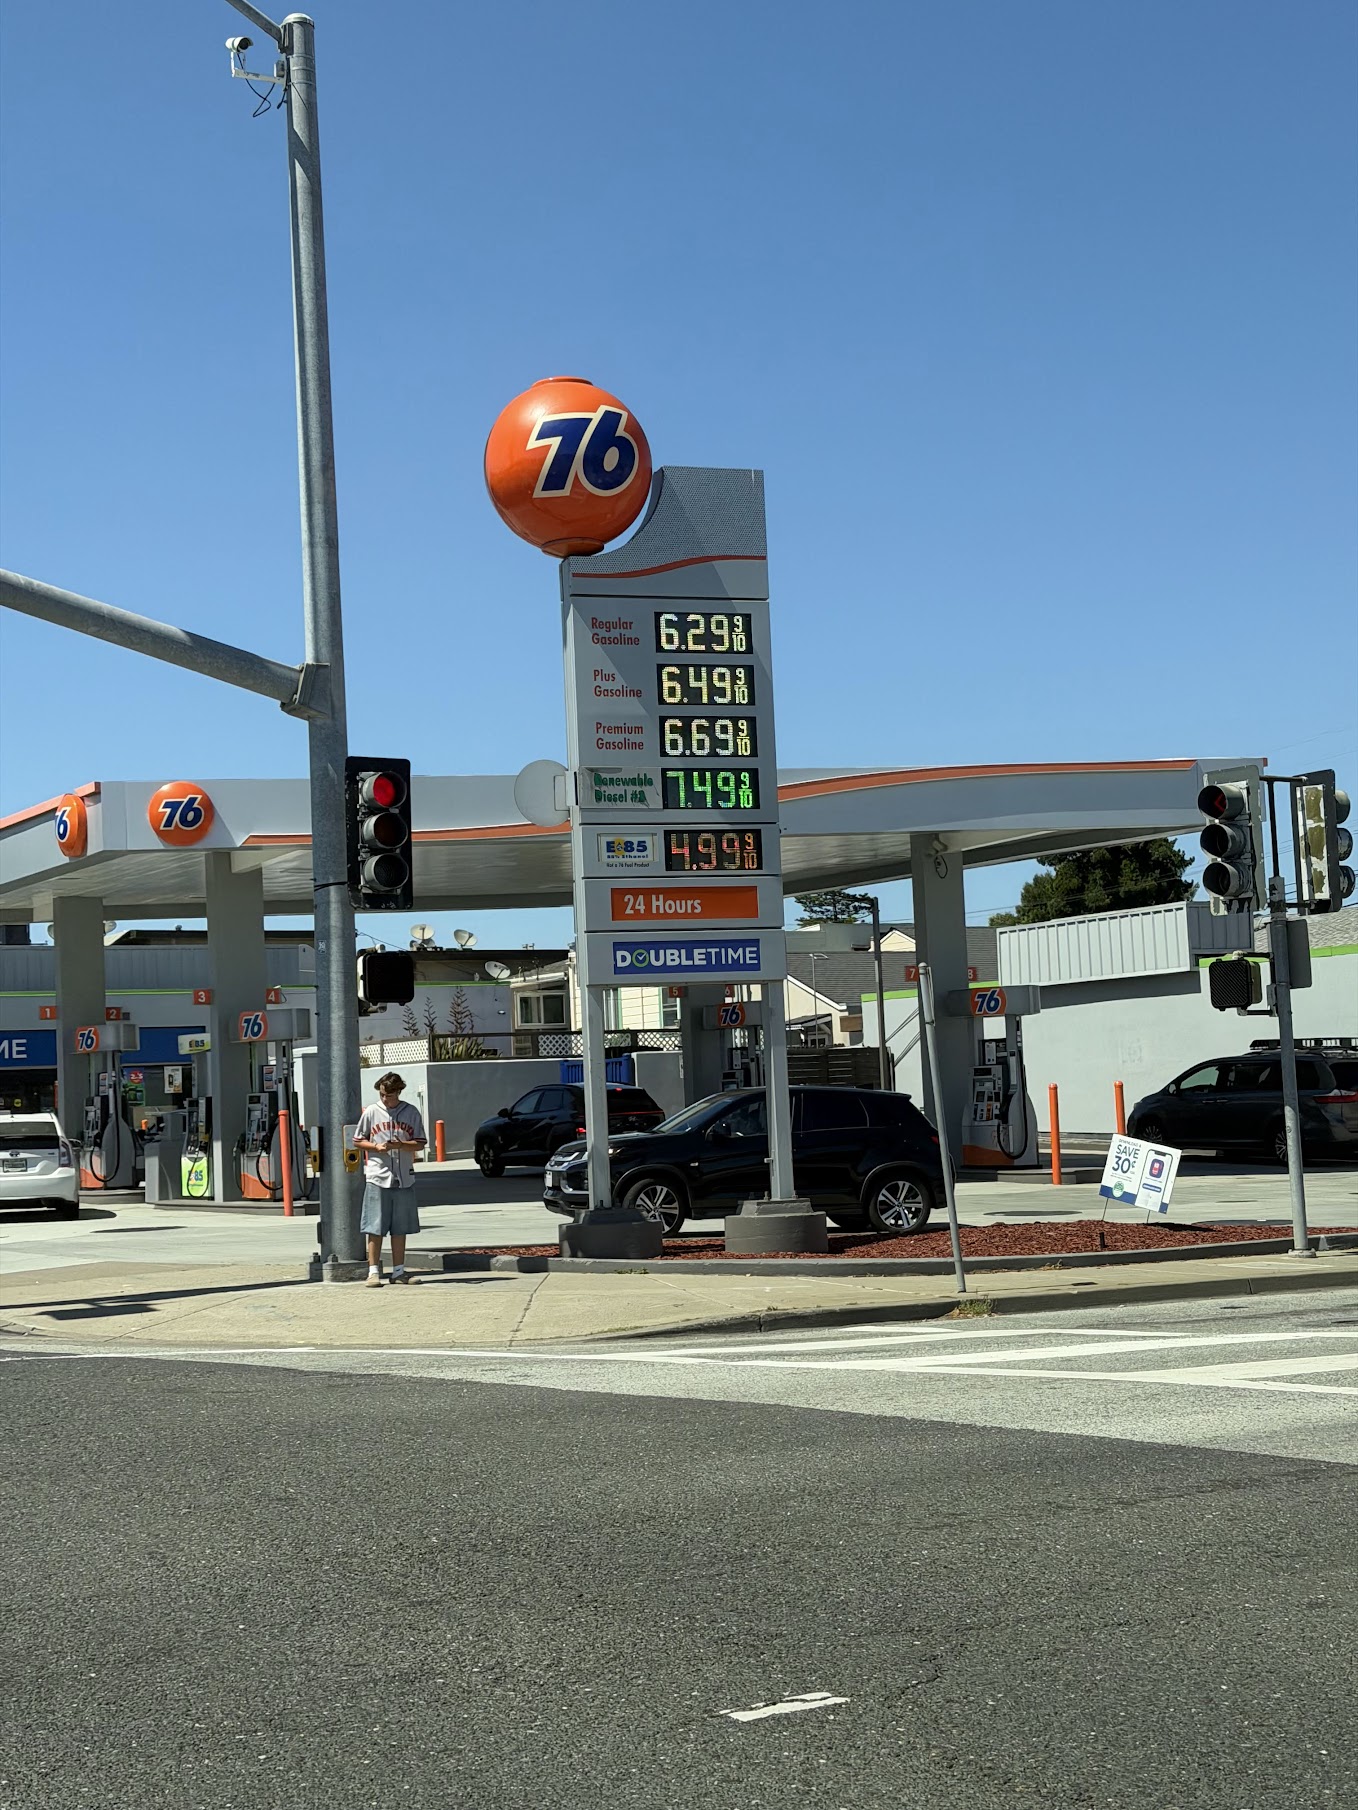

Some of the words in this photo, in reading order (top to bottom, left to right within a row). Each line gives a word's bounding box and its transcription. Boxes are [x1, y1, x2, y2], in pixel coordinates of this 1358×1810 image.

[526, 405, 639, 498] 76
[591, 617, 633, 633] Regular
[659, 613, 729, 651] 6.29
[591, 633, 640, 646] Gasoline
[593, 669, 616, 682] Plus
[594, 685, 642, 698] Gasoline
[661, 666, 732, 704] 6.49
[595, 722, 644, 735] Premium
[596, 737, 644, 751] Gasoline
[664, 718, 734, 756] 6.69
[594, 772, 654, 787] Renewable
[594, 789, 627, 803] Diesel
[666, 771, 736, 808] 7.49
[158, 795, 205, 830] 76
[670, 832, 741, 870] 4.99
[624, 894, 646, 915] 24
[651, 894, 702, 914] Hours
[616, 947, 758, 968] DOUBLETIME
[909, 968, 916, 979] 7
[197, 991, 206, 1002] 3
[268, 990, 277, 1002] 4
[672, 987, 679, 996] 5
[724, 986, 731, 995] 6
[974, 989, 1002, 1015] 76
[44, 1007, 50, 1018] 1
[109, 1008, 117, 1019] 2
[720, 1003, 742, 1026] 76
[241, 1012, 264, 1040] 76
[77, 1027, 96, 1051] 76
[0, 1039, 27, 1059] ME
[1116, 1144, 1140, 1159] SAVE
